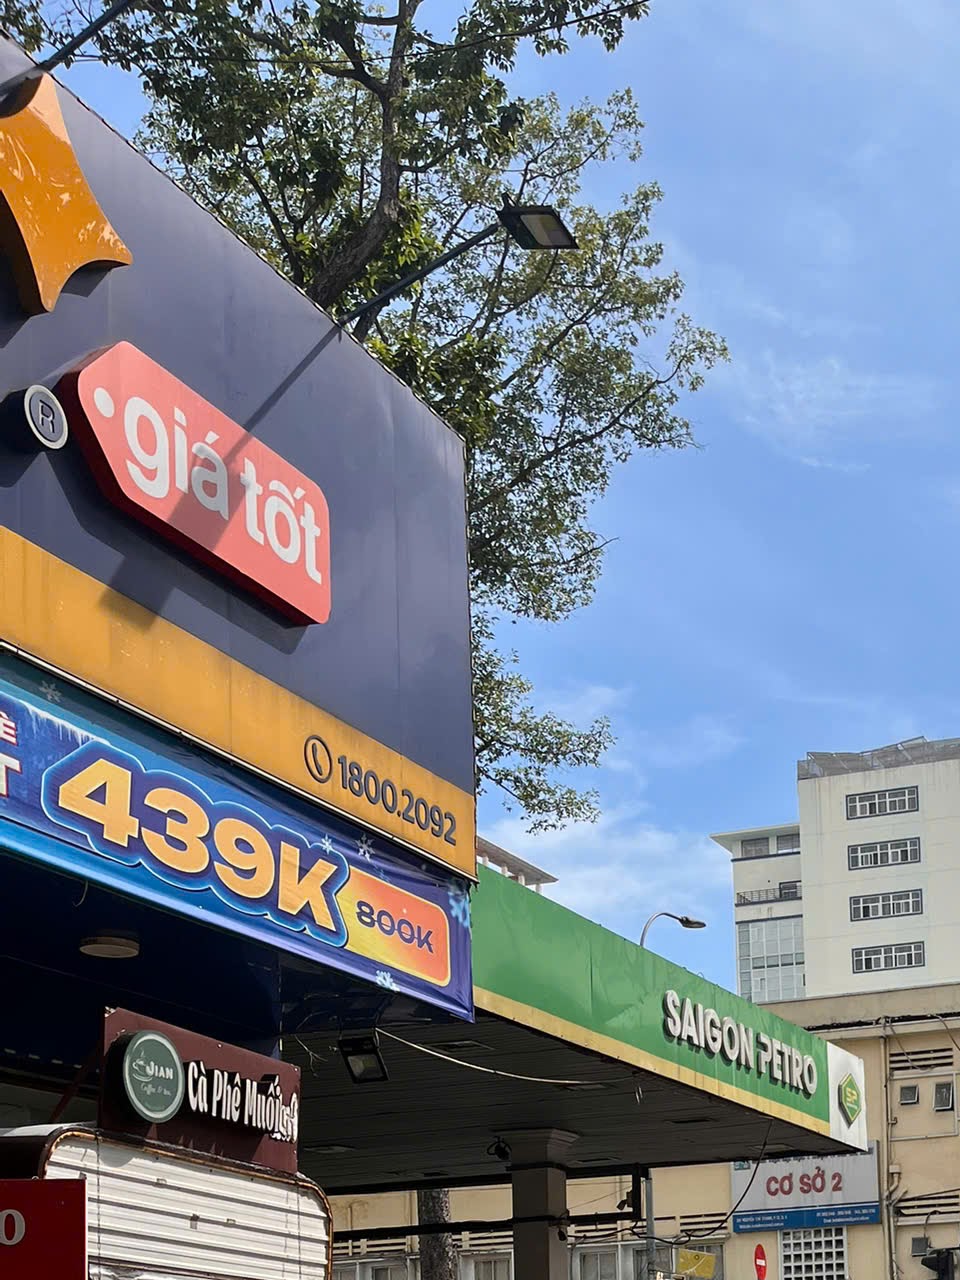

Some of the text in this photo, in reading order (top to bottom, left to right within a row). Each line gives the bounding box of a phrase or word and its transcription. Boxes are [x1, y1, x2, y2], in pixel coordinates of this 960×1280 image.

[123, 397, 322, 585] giá tốt
[338, 755, 457, 846] 1800.2092
[58, 758, 434, 954] 439K 800K
[187, 1061, 208, 1113] Cà
[211, 1069, 241, 1122] Phê
[664, 989, 818, 1096] SAIGON PETRO
[766, 1166, 843, 1197] CƠ SỞ 2
